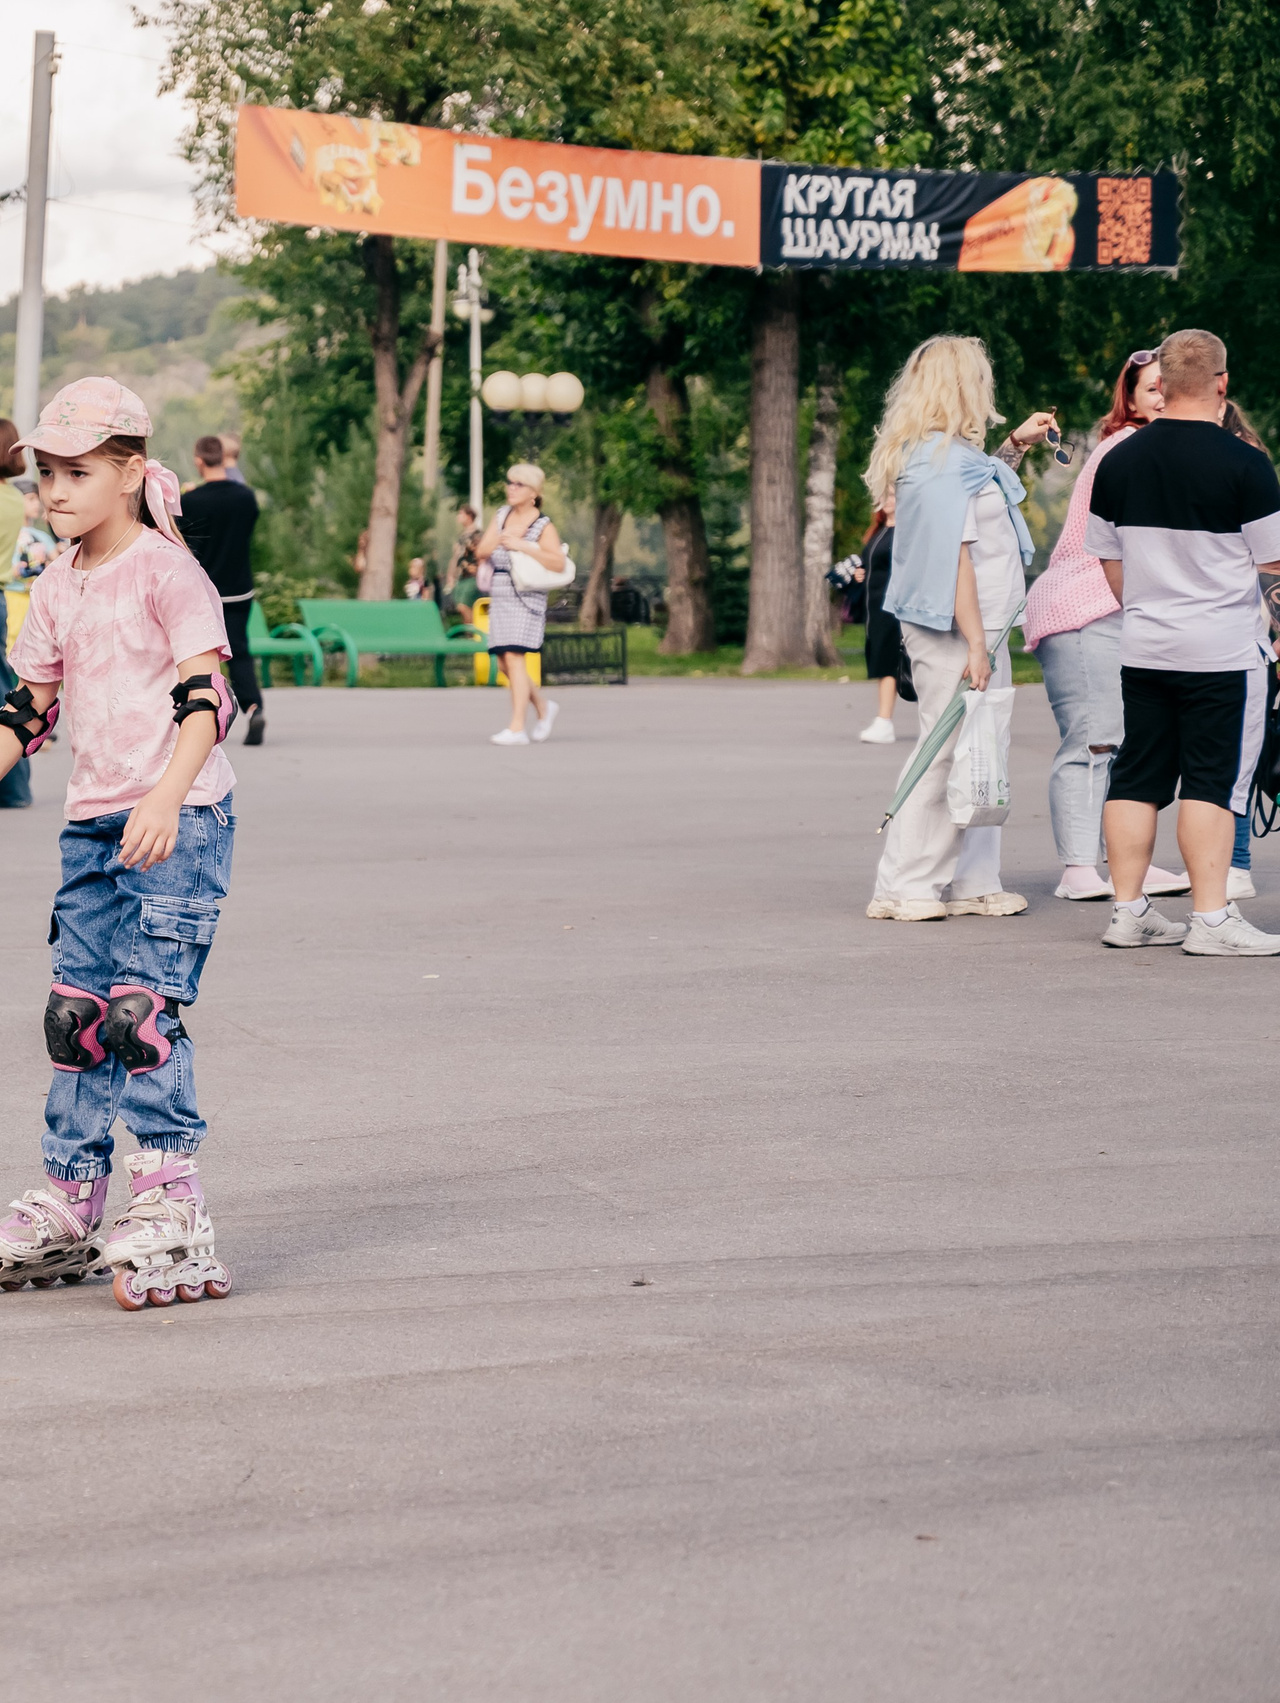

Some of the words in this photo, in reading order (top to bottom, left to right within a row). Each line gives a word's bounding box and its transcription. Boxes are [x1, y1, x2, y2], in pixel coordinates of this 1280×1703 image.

[452, 143, 736, 241] Безумно.
[783, 174, 916, 218] КРУТАЯ
[781, 217, 940, 260] ШАУРМА!
